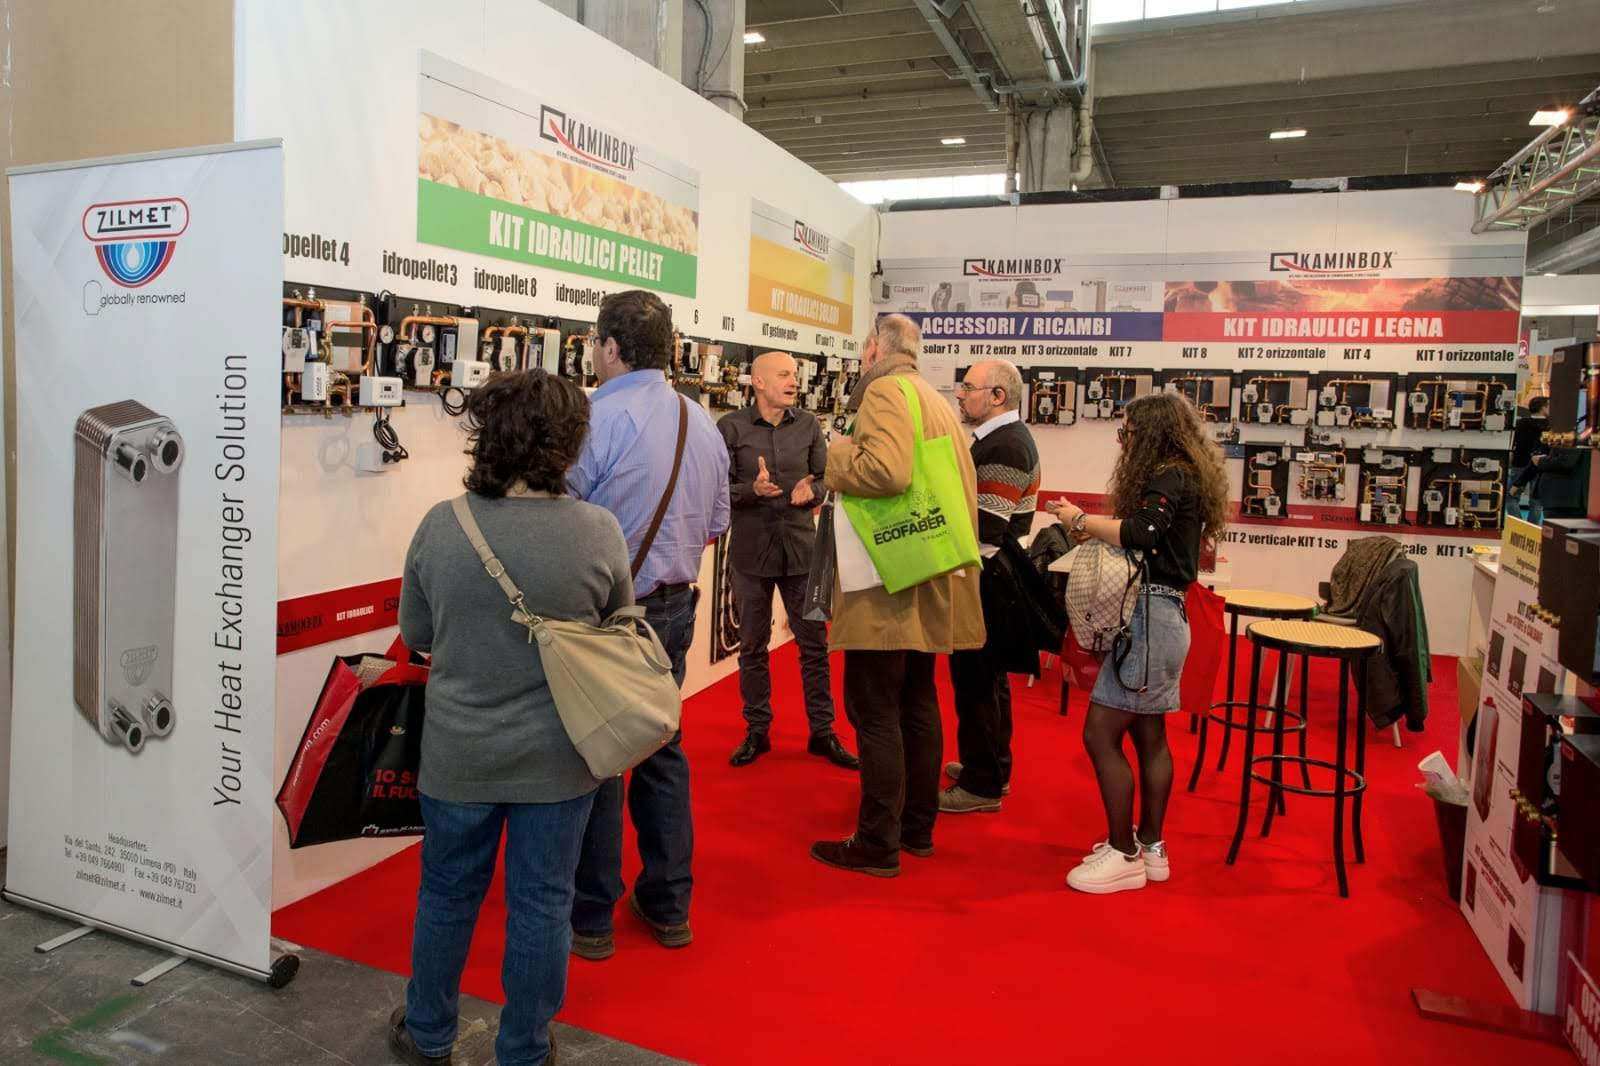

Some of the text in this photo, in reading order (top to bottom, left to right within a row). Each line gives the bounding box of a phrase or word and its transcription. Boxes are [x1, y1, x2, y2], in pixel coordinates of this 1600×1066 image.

[568, 118, 636, 171] KAMINBOX
[97, 206, 172, 233] ZILMET
[489, 210, 663, 282] KIT IDRAULICI PELLET
[340, 242, 350, 266] 4
[1300, 252, 1393, 270] KAMINBOX
[382, 250, 458, 286] idropellet 3
[987, 259, 1062, 275] KAMINBOX
[474, 268, 537, 297] idropellet 8
[100, 291, 186, 307] globally renowned
[555, 283, 600, 307] idropellet
[722, 316, 731, 331] KIT
[921, 318, 1015, 336] ACCESSORI
[1033, 317, 1112, 336] RICAMBI
[1223, 317, 1443, 338] KIT IDRAULICI LEGNA
[923, 344, 960, 355] solar T 3
[970, 345, 1017, 356] KIT 2 extra
[1021, 345, 1098, 357] KIT 3 orizzontale
[1109, 346, 1132, 358] KIT 7
[1182, 347, 1207, 359] KIT 8
[1238, 347, 1326, 360] KIT 2 orizzontale
[1344, 348, 1371, 361] KIT 4
[1416, 349, 1514, 363] KIT 1 orizzontale
[873, 514, 946, 546] ECOFABER
[1239, 532, 1247, 543] 2
[1248, 533, 1297, 547] verticale
[1297, 536, 1316, 548] KIT
[1318, 537, 1323, 548] 1
[1436, 544, 1456, 557] KIT
[1458, 545, 1464, 557] 1
[213, 355, 252, 806] Your Heat Exchanger Solution
[376, 769, 397, 784] IO
[372, 785, 386, 798] IL
